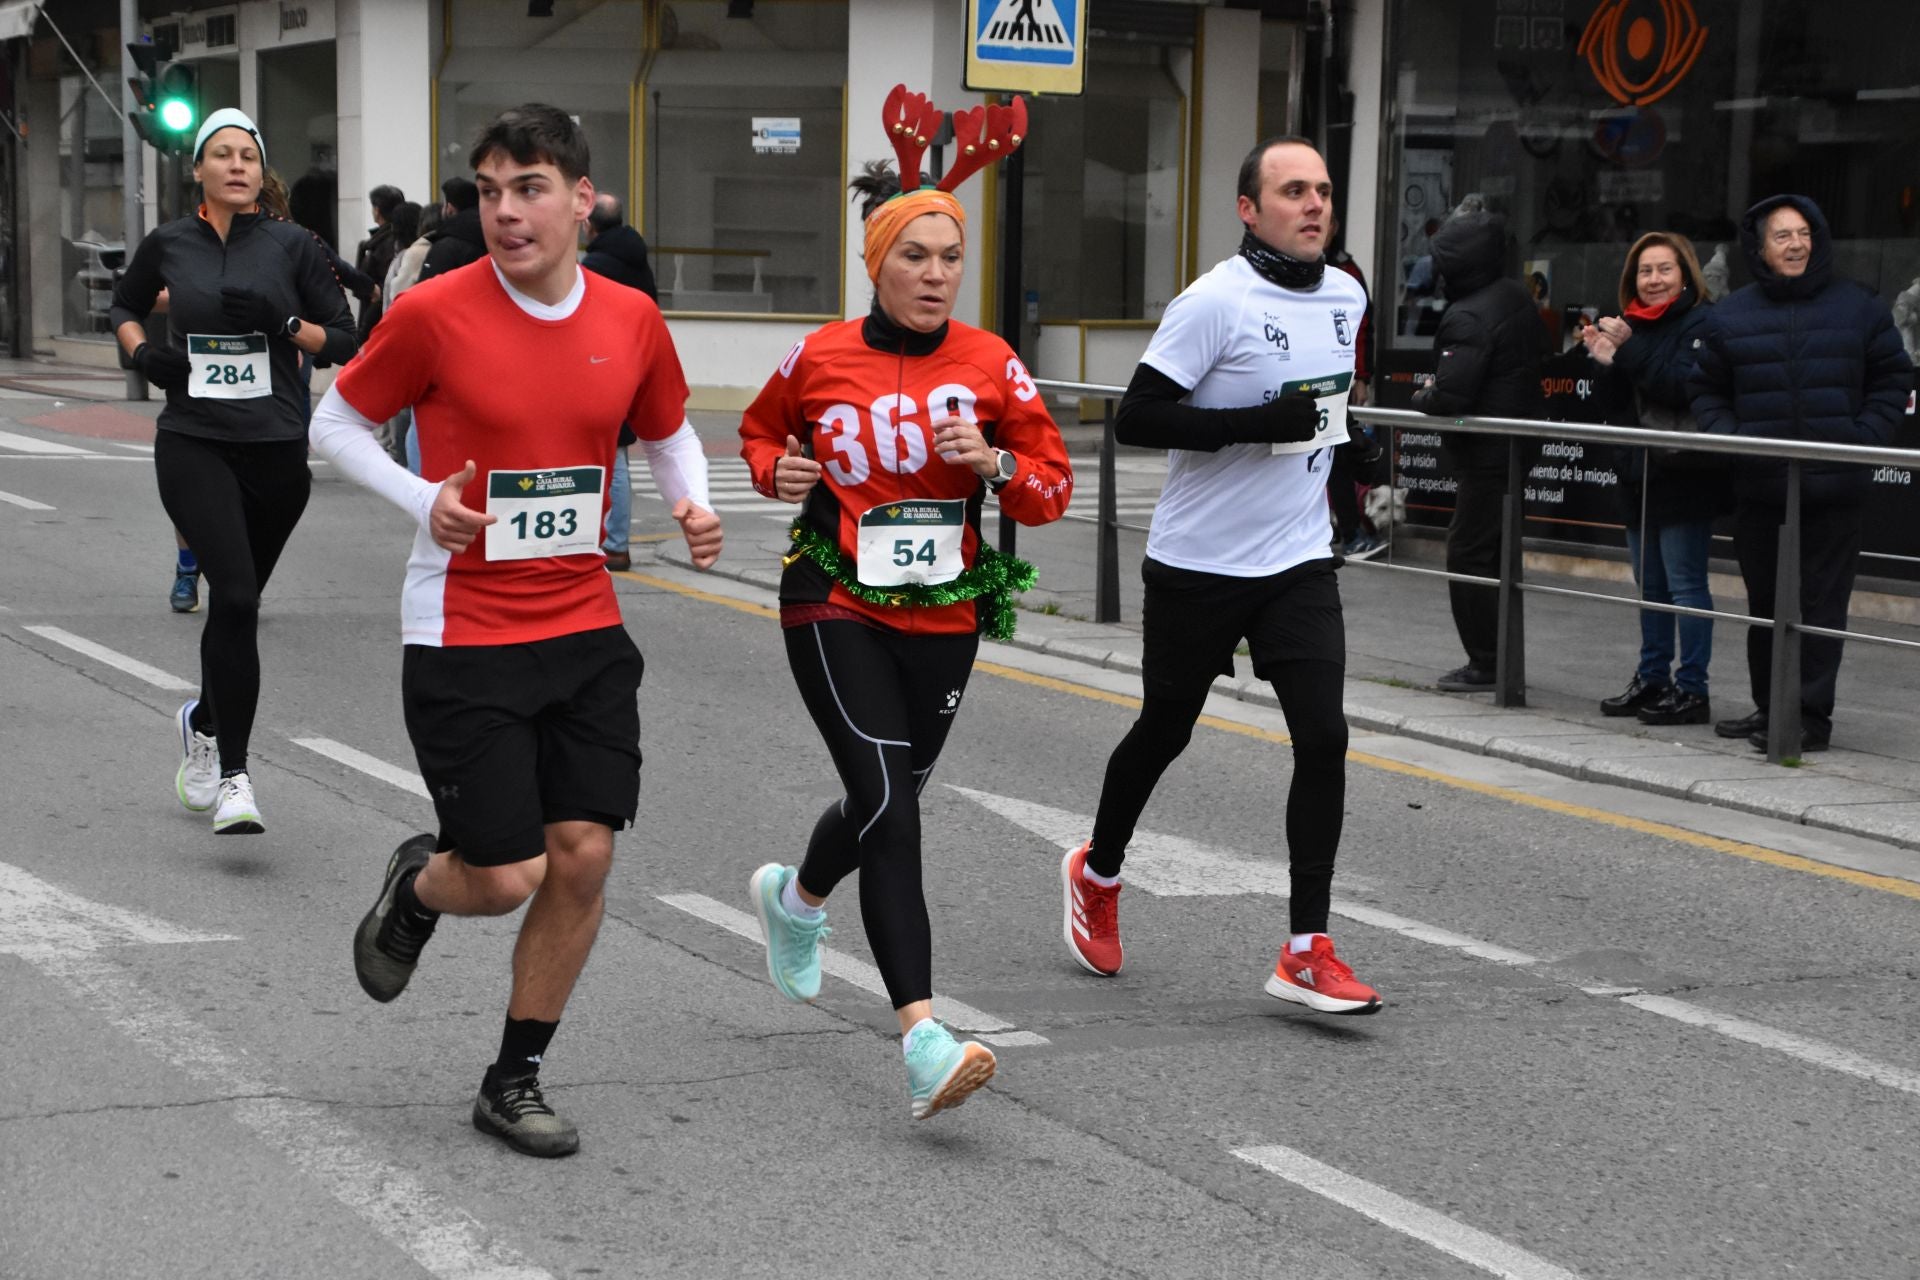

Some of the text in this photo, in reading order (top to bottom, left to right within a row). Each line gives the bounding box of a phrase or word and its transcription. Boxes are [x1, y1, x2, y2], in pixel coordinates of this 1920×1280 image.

[206, 364, 256, 385] 284
[1006, 357, 1037, 402] 3
[1541, 378, 1574, 398] guro
[1317, 408, 1330, 432] 6
[1412, 453, 1437, 468] visión
[1560, 464, 1574, 481] de
[1574, 465, 1584, 481] la
[1537, 486, 1565, 502] visual
[510, 508, 577, 540] 183
[892, 539, 937, 567] 54
